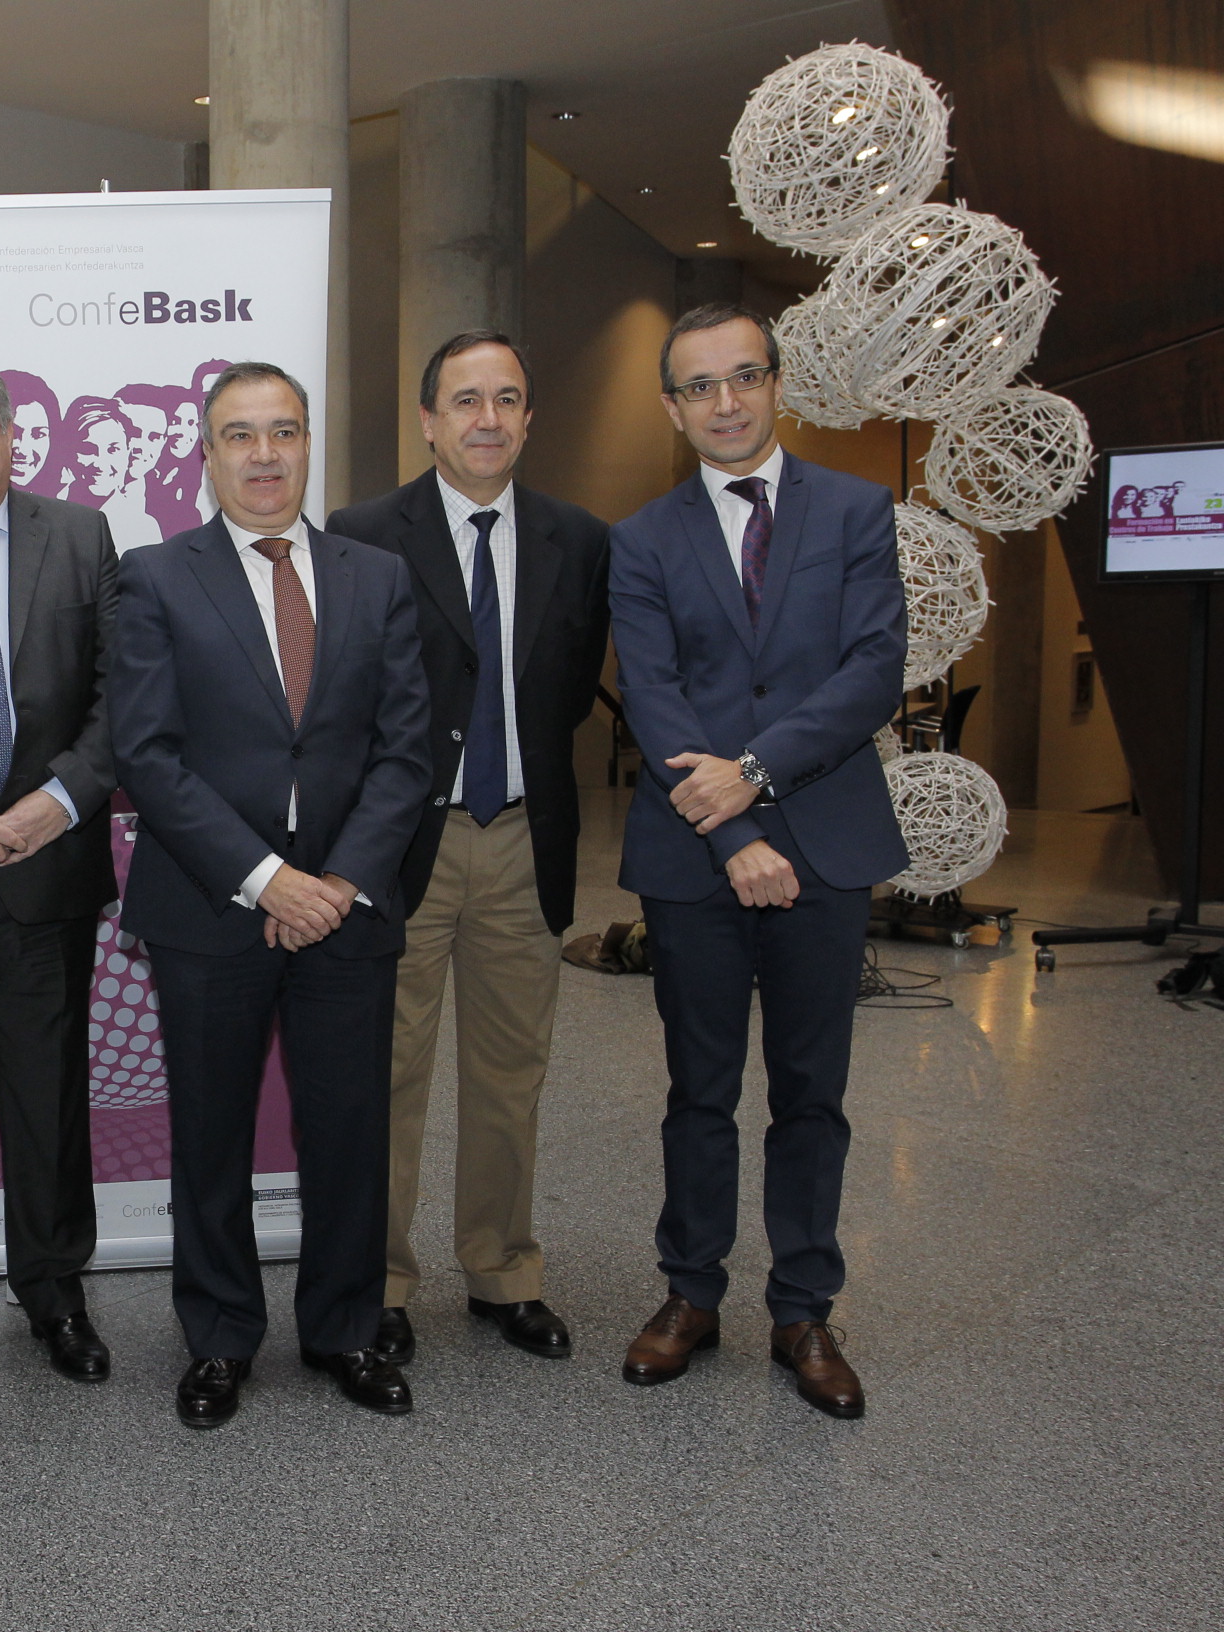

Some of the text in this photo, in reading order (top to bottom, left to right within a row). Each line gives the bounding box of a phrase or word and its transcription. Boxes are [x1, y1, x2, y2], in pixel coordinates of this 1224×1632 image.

[58, 245, 114, 256] Empresarial
[116, 244, 144, 254] Vasca
[65, 261, 144, 272] Konfederakuntza
[28, 289, 254, 328] ConfeBask
[122, 1202, 174, 1218] ConfeB
